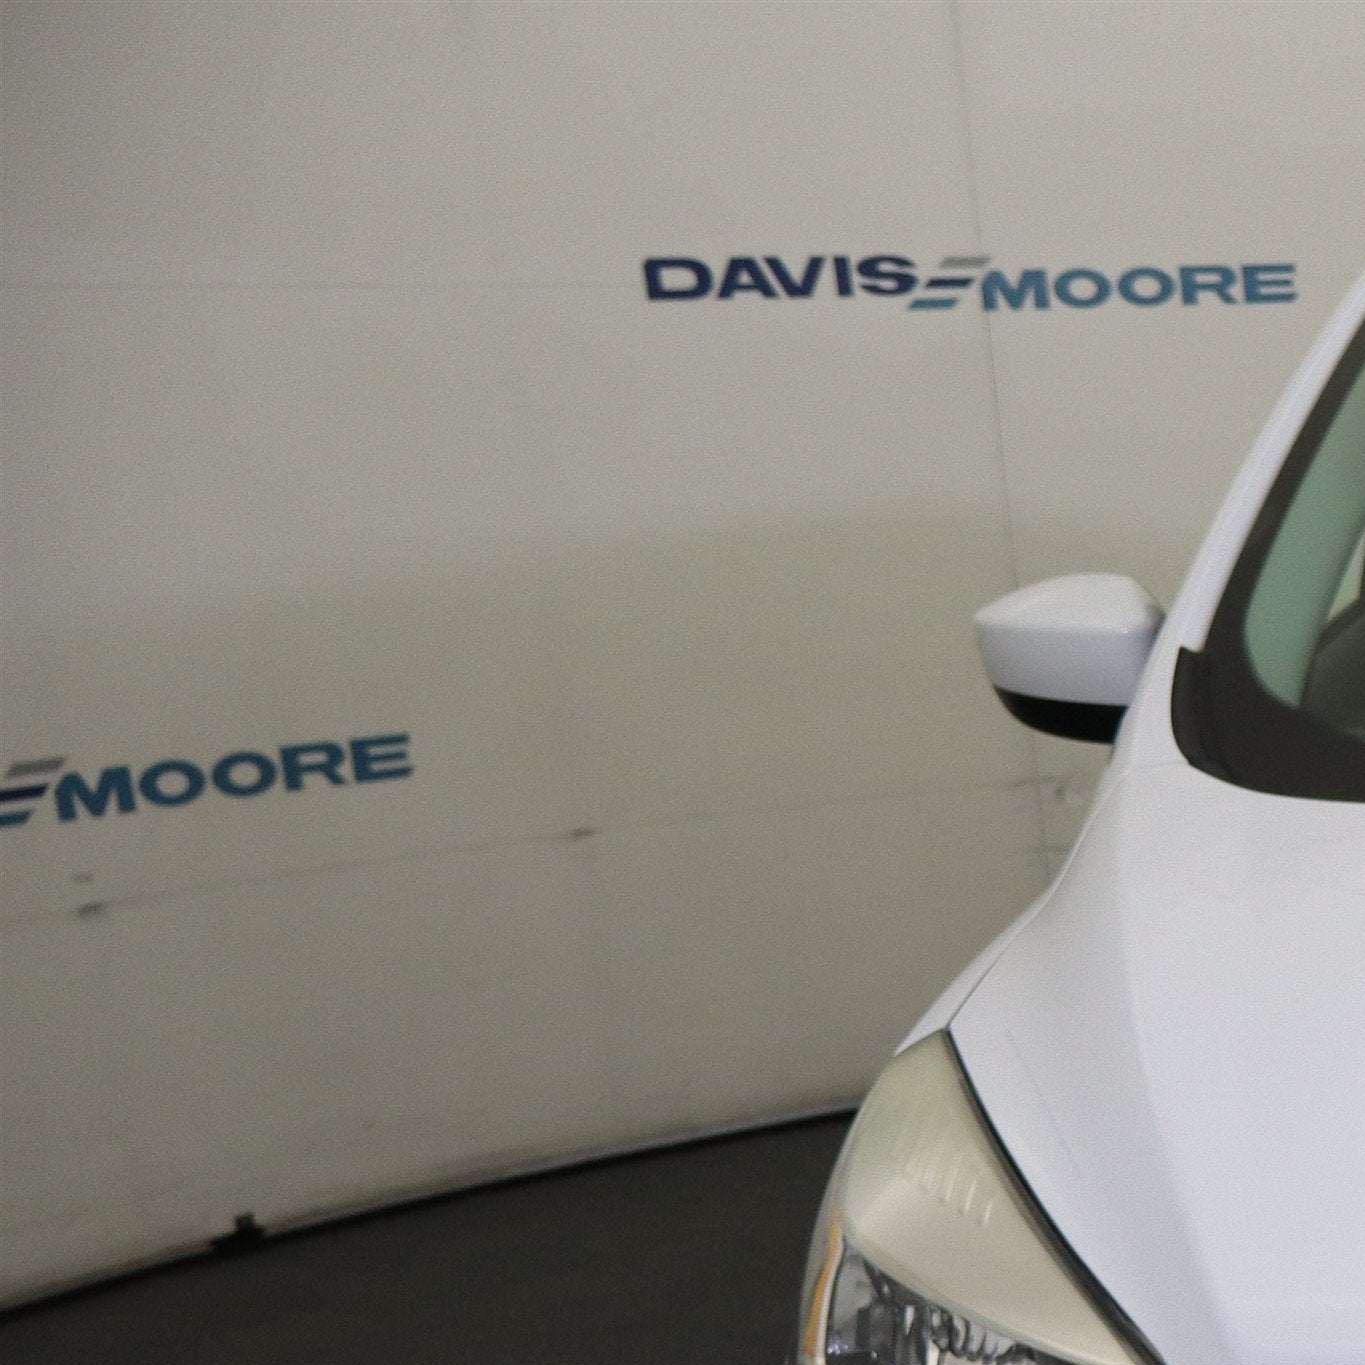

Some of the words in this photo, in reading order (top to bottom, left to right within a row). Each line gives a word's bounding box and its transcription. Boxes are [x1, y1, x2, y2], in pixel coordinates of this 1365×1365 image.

[643, 255, 918, 301] DAVIS
[981, 263, 1298, 311] MOORE
[54, 732, 414, 823] MOORE
